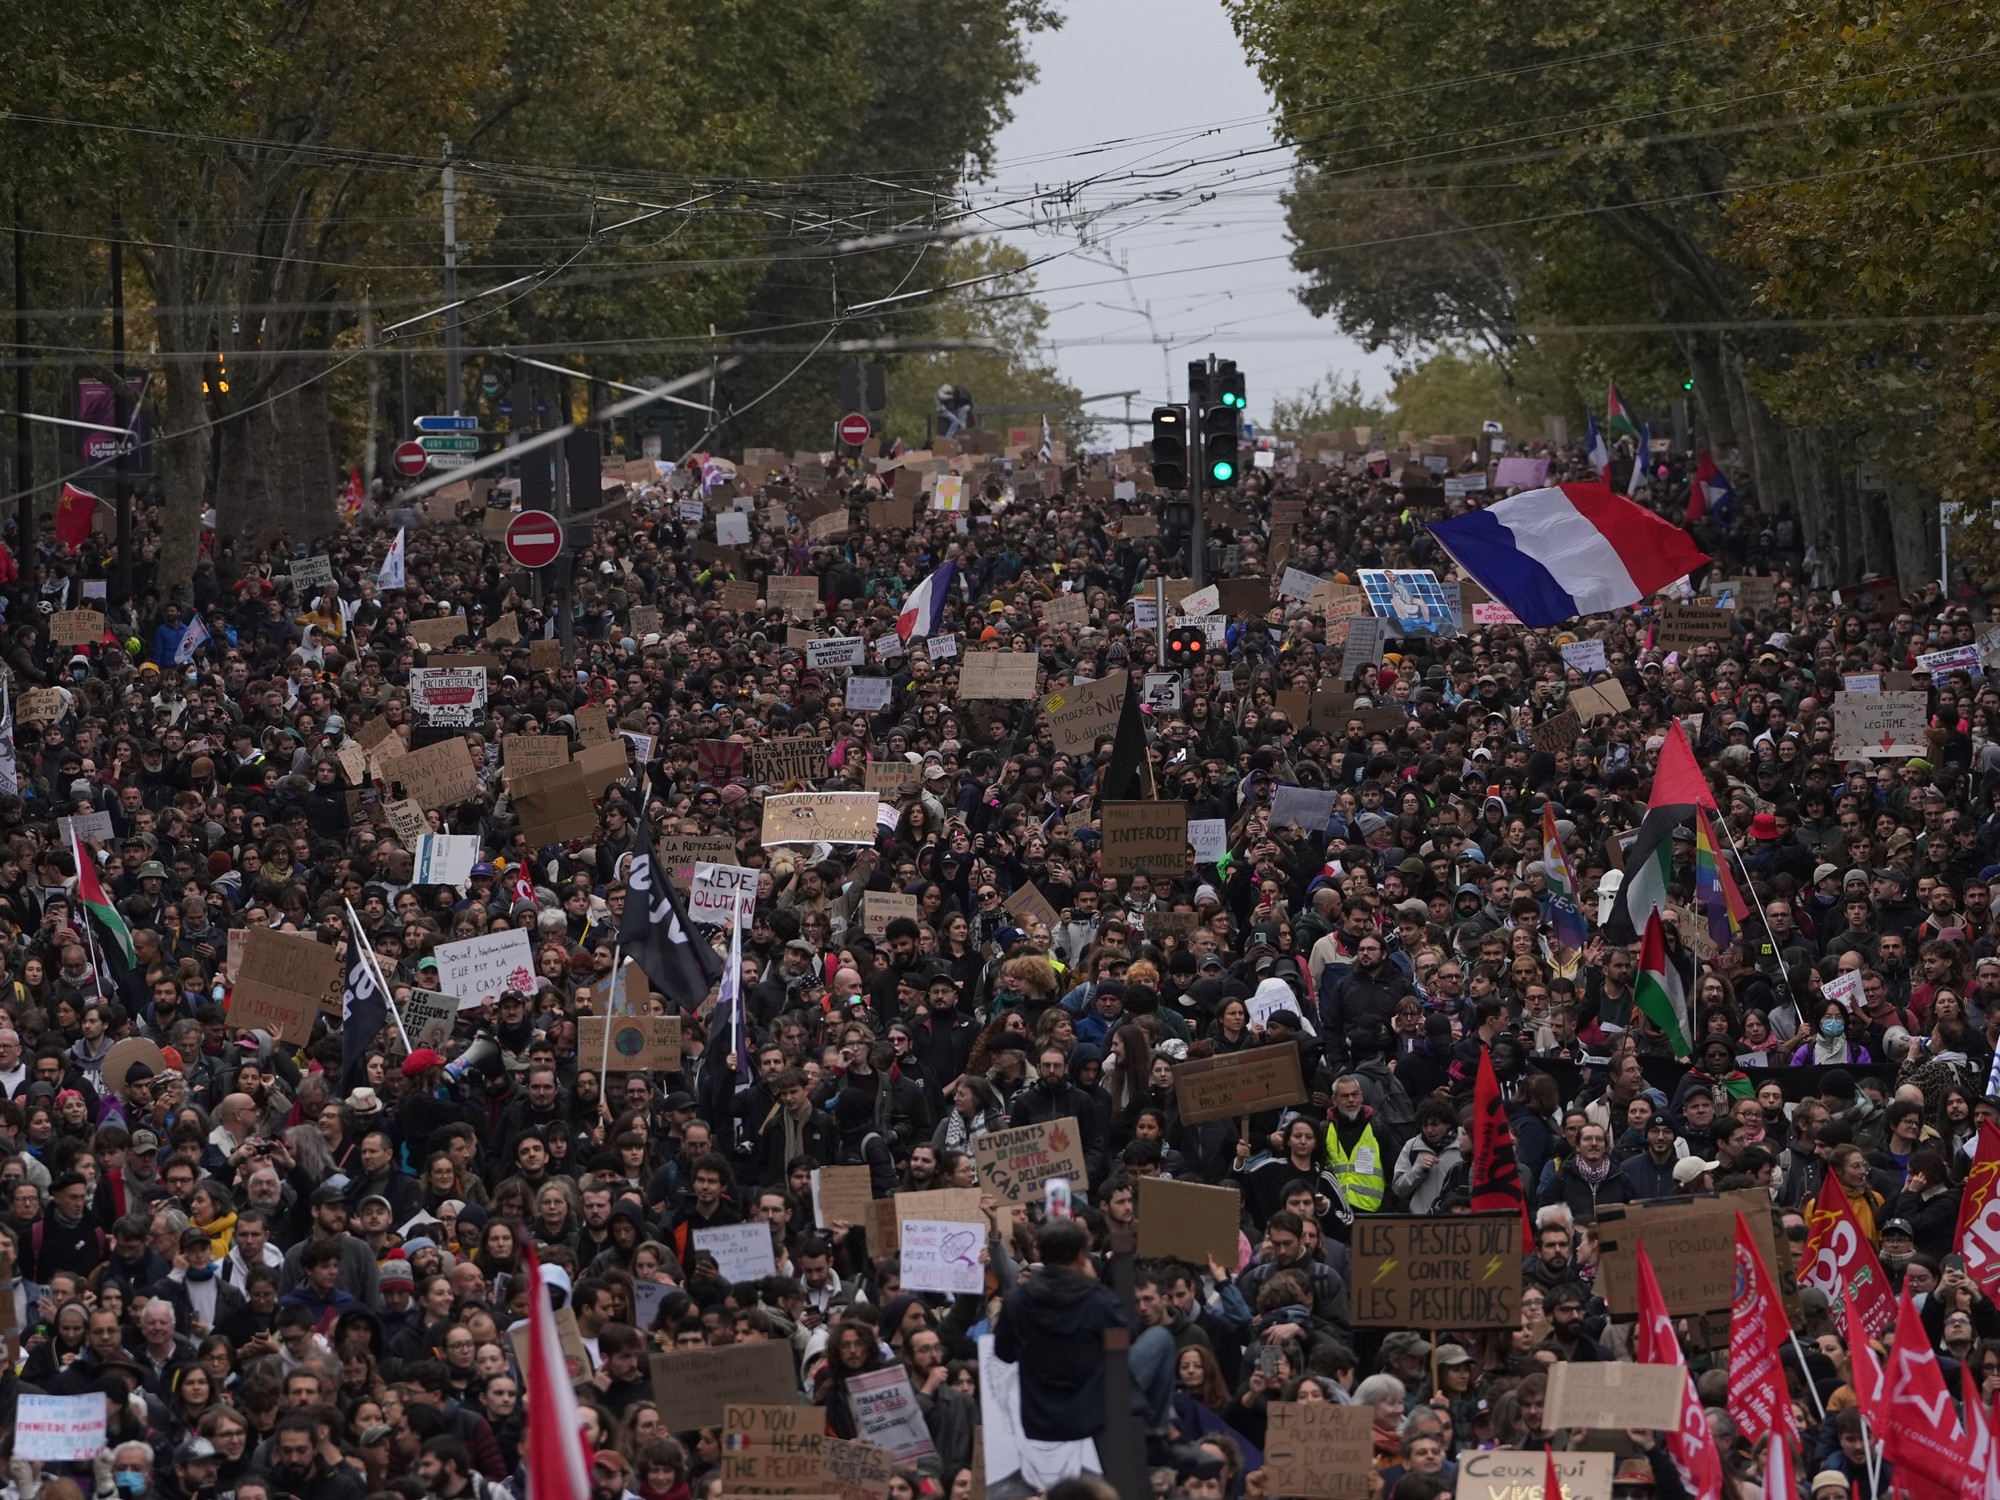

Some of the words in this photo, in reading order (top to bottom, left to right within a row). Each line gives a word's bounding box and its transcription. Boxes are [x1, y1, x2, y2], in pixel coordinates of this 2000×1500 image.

[1664, 608, 1673, 619] LA
[1712, 621, 1728, 630] PAS
[1660, 634, 1676, 642] NOS
[818, 656, 828, 666] LA
[507, 736, 549, 751] ARTICLE
[552, 736, 560, 750] 7
[754, 742, 778, 753] T'AS
[782, 742, 796, 752] EU
[800, 740, 824, 750] PEUR
[425, 743, 450, 764] EN
[754, 750, 782, 760] QU'ON
[754, 754, 827, 784] BASTILLE?
[816, 795, 836, 806] SOUS
[1110, 826, 1182, 843] INTERDIT
[1204, 824, 1222, 835] DOIT
[665, 840, 678, 852] LA
[1200, 836, 1221, 846] CAMP
[706, 854, 718, 864] LA
[452, 966, 469, 979] ELLE
[474, 962, 488, 974] EST
[496, 958, 508, 968] LA
[411, 990, 428, 1004] LES
[455, 982, 468, 997] LA
[408, 1002, 450, 1020] CASSEURS
[653, 1020, 677, 1028] POUR
[653, 1028, 679, 1036] NOTRE
[1199, 1096, 1216, 1110] PAS
[1218, 1092, 1232, 1105] UN
[978, 1124, 1045, 1152] ETUDIANTS
[1008, 1150, 1050, 1171] CONTRE
[981, 1160, 1021, 1201] ACAB
[1359, 1224, 1395, 1257] LES
[1408, 1222, 1472, 1255] PESTES
[1478, 1218, 1513, 1255] D'ICI
[1668, 1236, 1735, 1260] POUDLA
[1408, 1260, 1472, 1281] CONTRE
[1358, 1287, 1396, 1320] LES
[1408, 1283, 1512, 1322] PESTICIDES
[728, 1408, 755, 1430] DO
[762, 1408, 796, 1431] YOU
[1318, 1427, 1372, 1441] ANTILLES
[772, 1432, 822, 1457] HEAR
[1904, 1428, 1966, 1466] COMMUNIST
[722, 1455, 758, 1479] THE
[764, 1455, 821, 1479] PEOPLE
[1464, 1454, 1535, 1478] Ceux
[1278, 1470, 1296, 1487] DE
